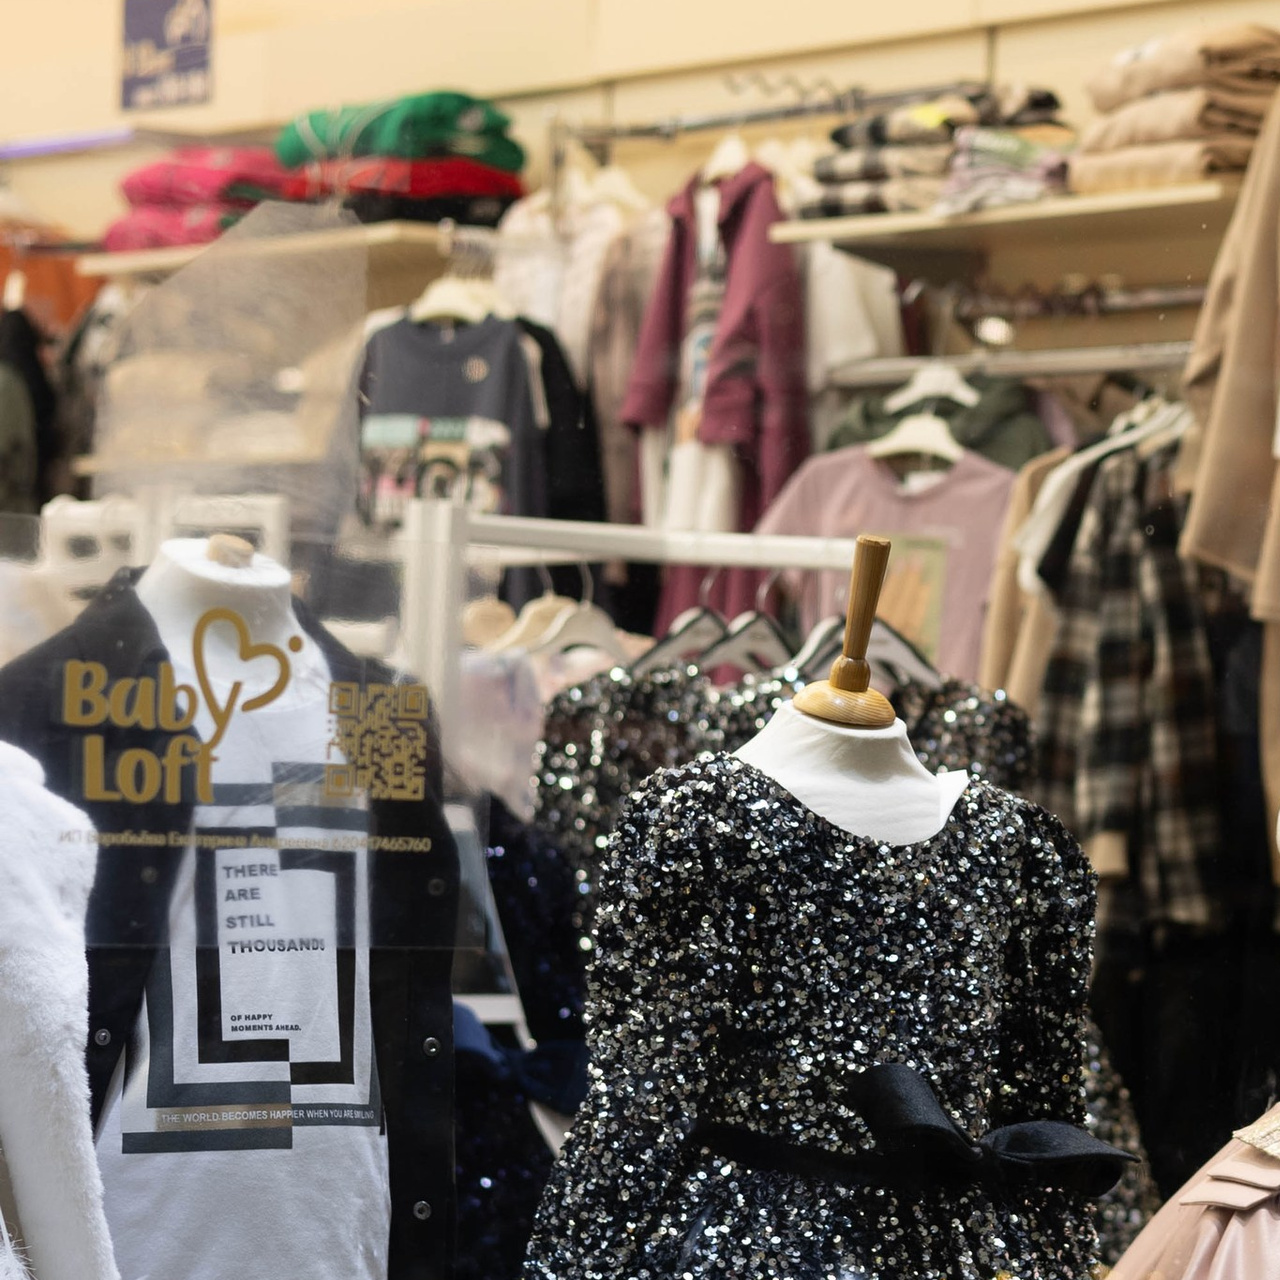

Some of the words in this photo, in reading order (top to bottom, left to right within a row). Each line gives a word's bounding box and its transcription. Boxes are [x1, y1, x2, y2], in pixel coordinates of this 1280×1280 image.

[62, 635, 250, 750] Baby
[83, 733, 219, 805] Loft
[222, 863, 278, 879] THERE
[224, 887, 261, 902] ARE
[226, 914, 275, 929] STILL
[230, 1014, 242, 1022] OF
[244, 1013, 273, 1021] HAPPY
[231, 1024, 273, 1032] MOMENTS
[275, 1024, 302, 1032] AHEAD.
[161, 1113, 180, 1123] THE
[222, 1110, 268, 1121] BECOMES
[269, 1109, 305, 1120] HAPPIER
[306, 1108, 329, 1119] WHEN
[329, 1108, 343, 1118] YOU
[343, 1108, 354, 1118] ARE
